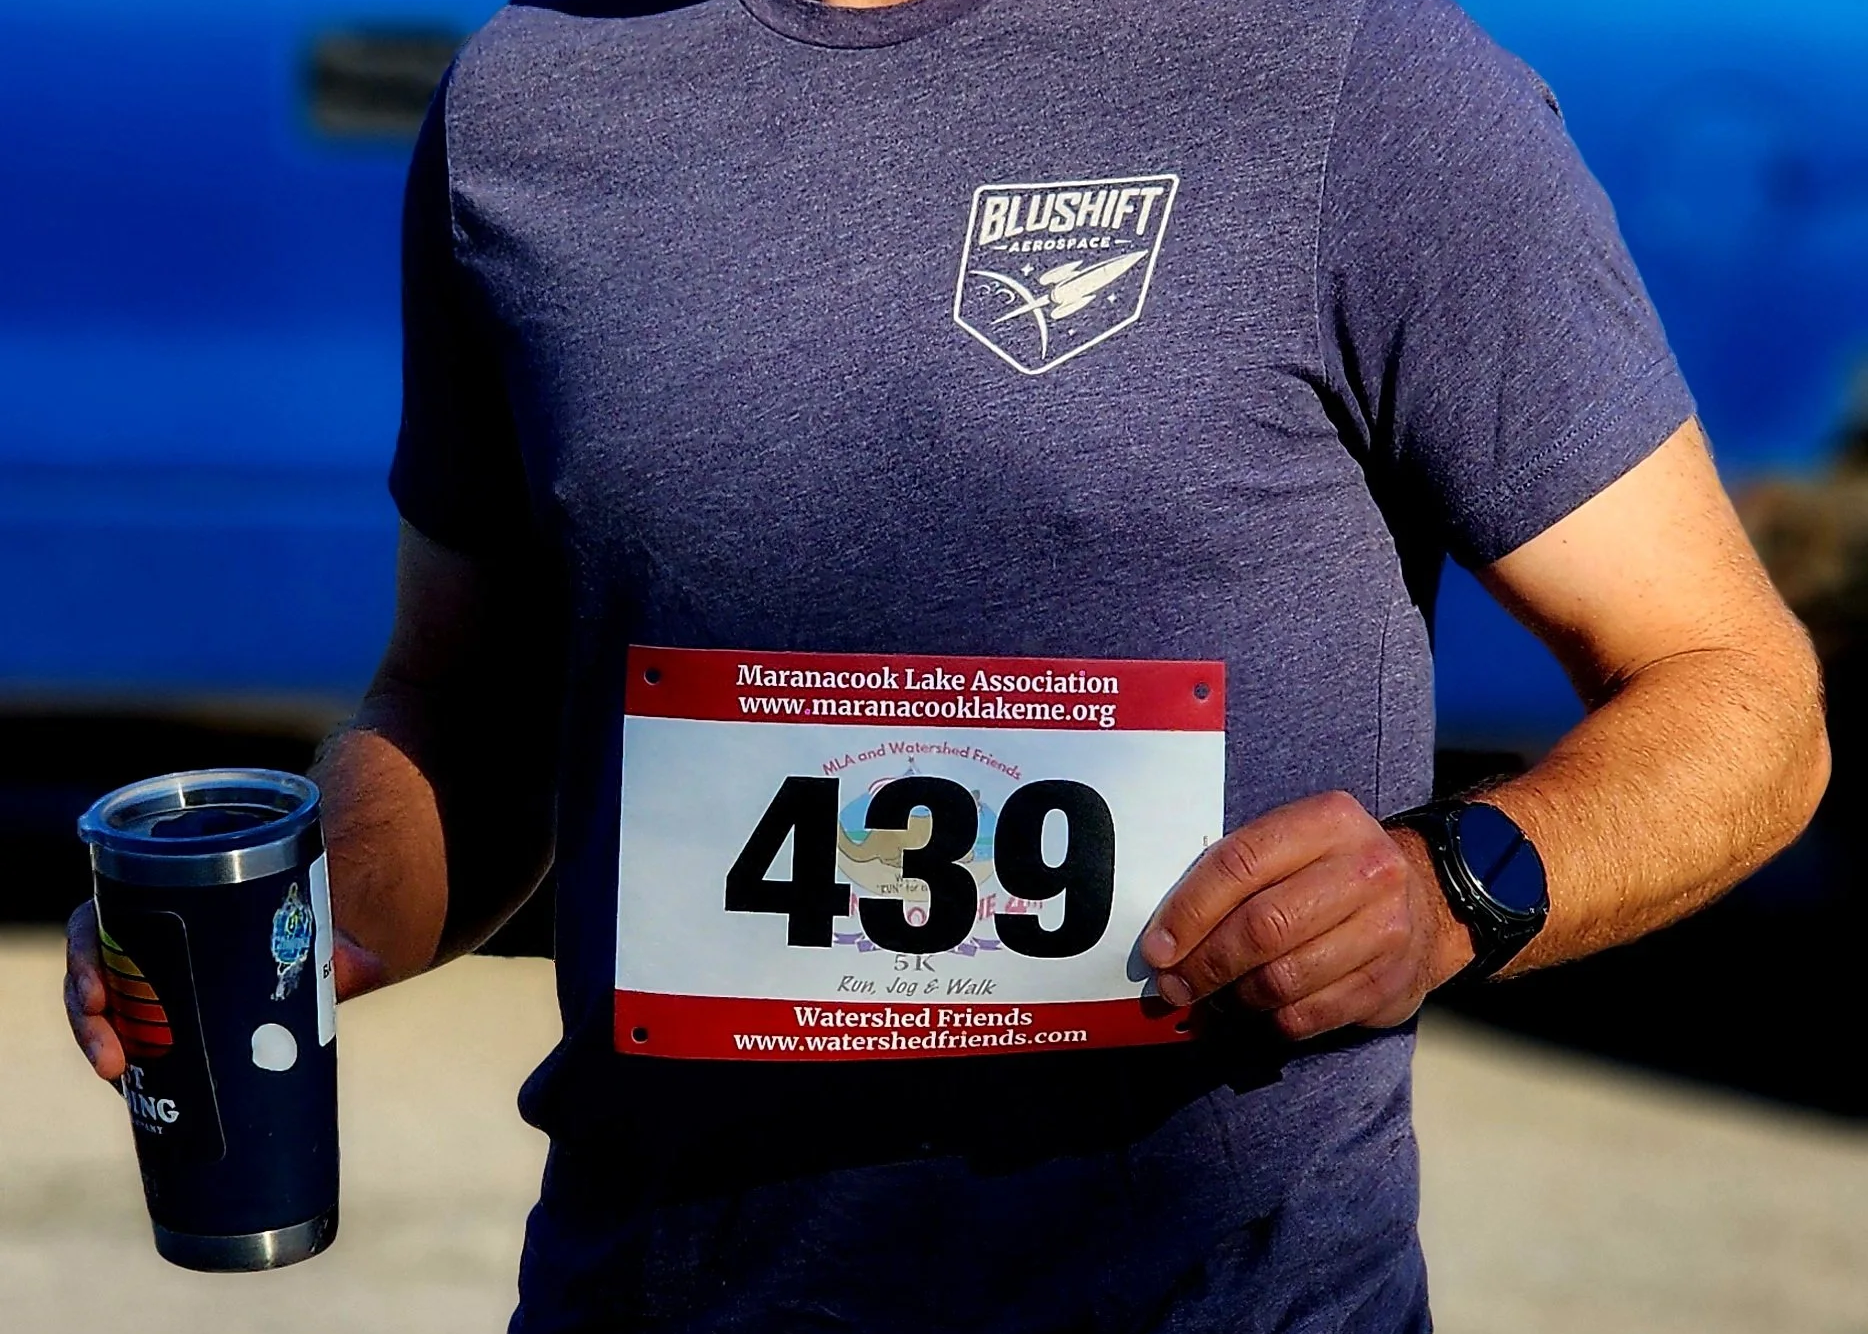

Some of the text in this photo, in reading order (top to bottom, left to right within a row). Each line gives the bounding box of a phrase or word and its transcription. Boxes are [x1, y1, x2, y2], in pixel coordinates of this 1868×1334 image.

[979, 187, 1163, 246] BLUSHIFT
[1008, 236, 1111, 253] AEROSPACE
[736, 664, 1119, 694] Maranacook Lake Association
[738, 695, 1116, 727] www.maranacooklakeme.org
[823, 741, 1021, 781] MLA and Watershed Friends
[724, 775, 1116, 959] 439
[837, 975, 997, 996] Run, Jog & Walk
[793, 1006, 1033, 1028] Watershed Friends
[733, 1028, 1088, 1052] www.watershedfriends.com
